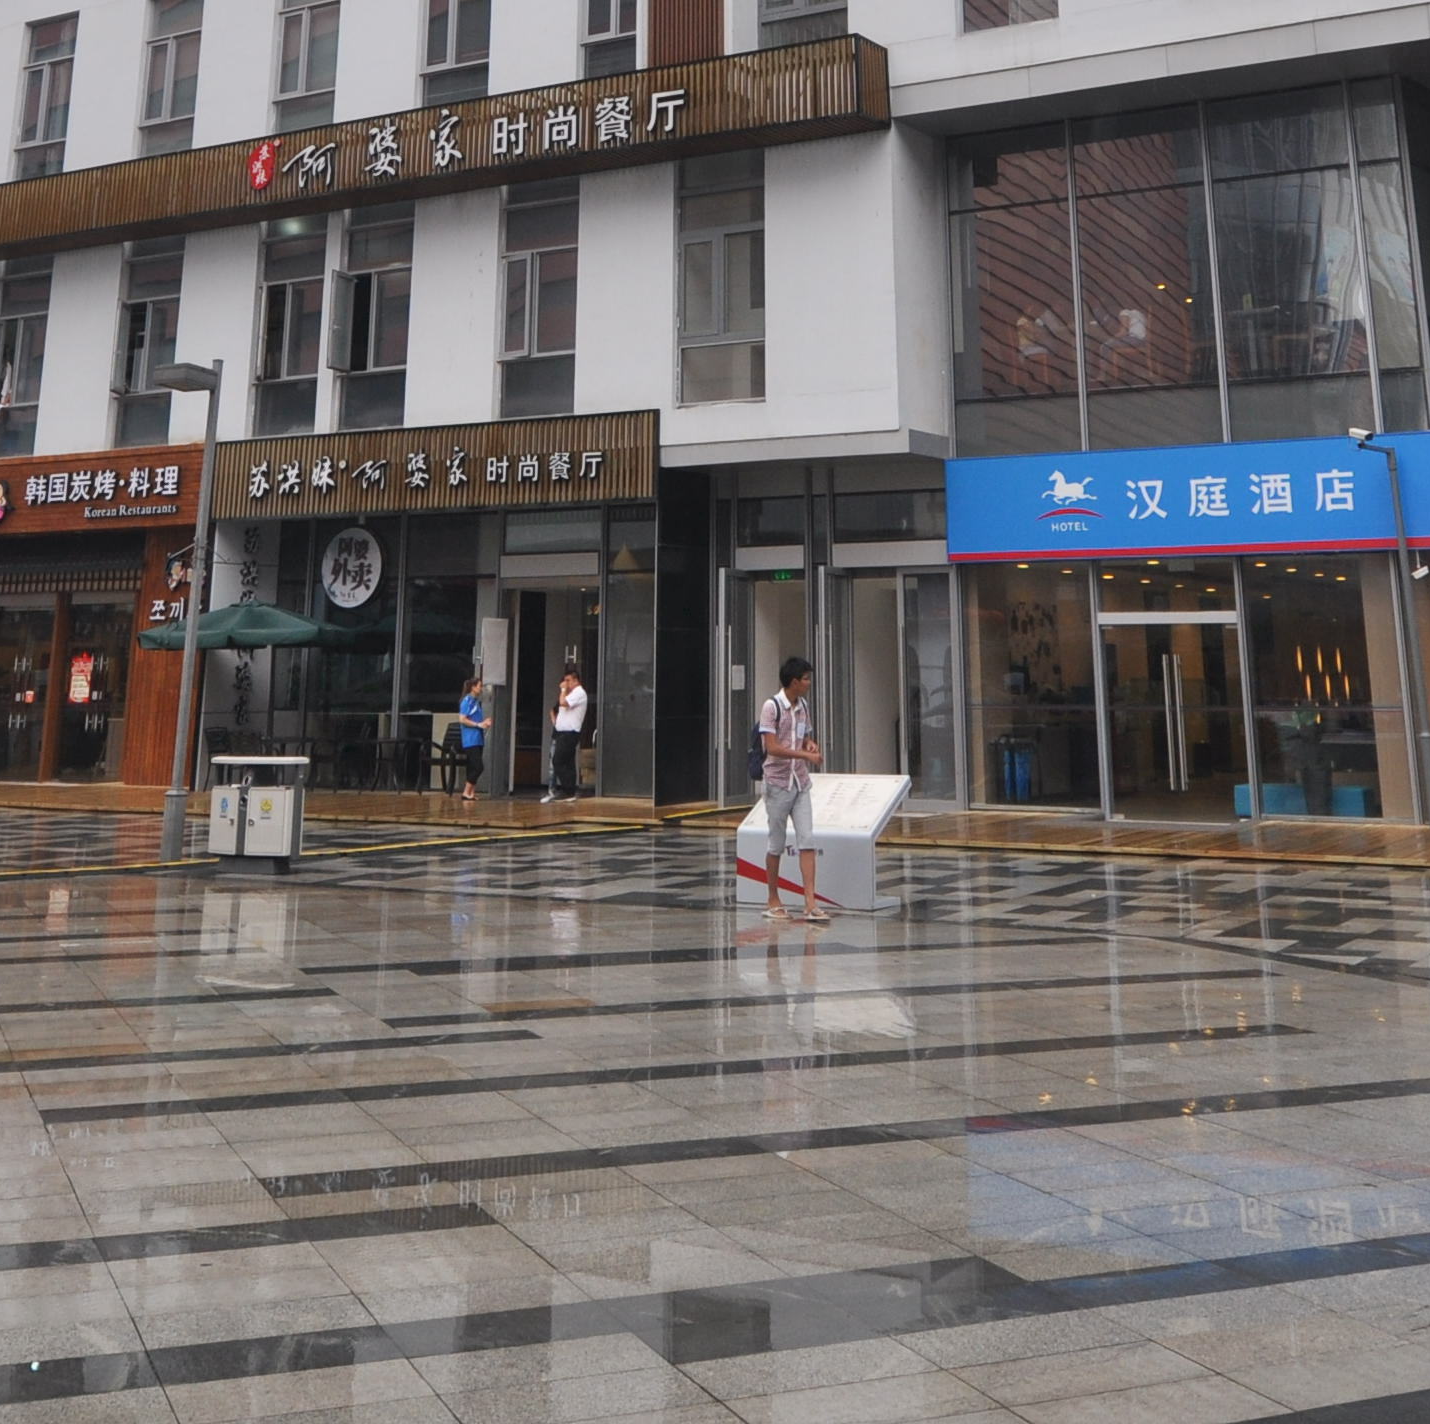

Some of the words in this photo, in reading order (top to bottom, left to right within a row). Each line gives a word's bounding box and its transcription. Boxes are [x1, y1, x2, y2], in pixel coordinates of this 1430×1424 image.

[1125, 469, 1355, 520] 汉庭酒店
[84, 506, 117, 518] Korean
[119, 504, 177, 516] Restaurants
[1051, 521, 1090, 532] HOTEL
[331, 557, 373, 592] 外卖
